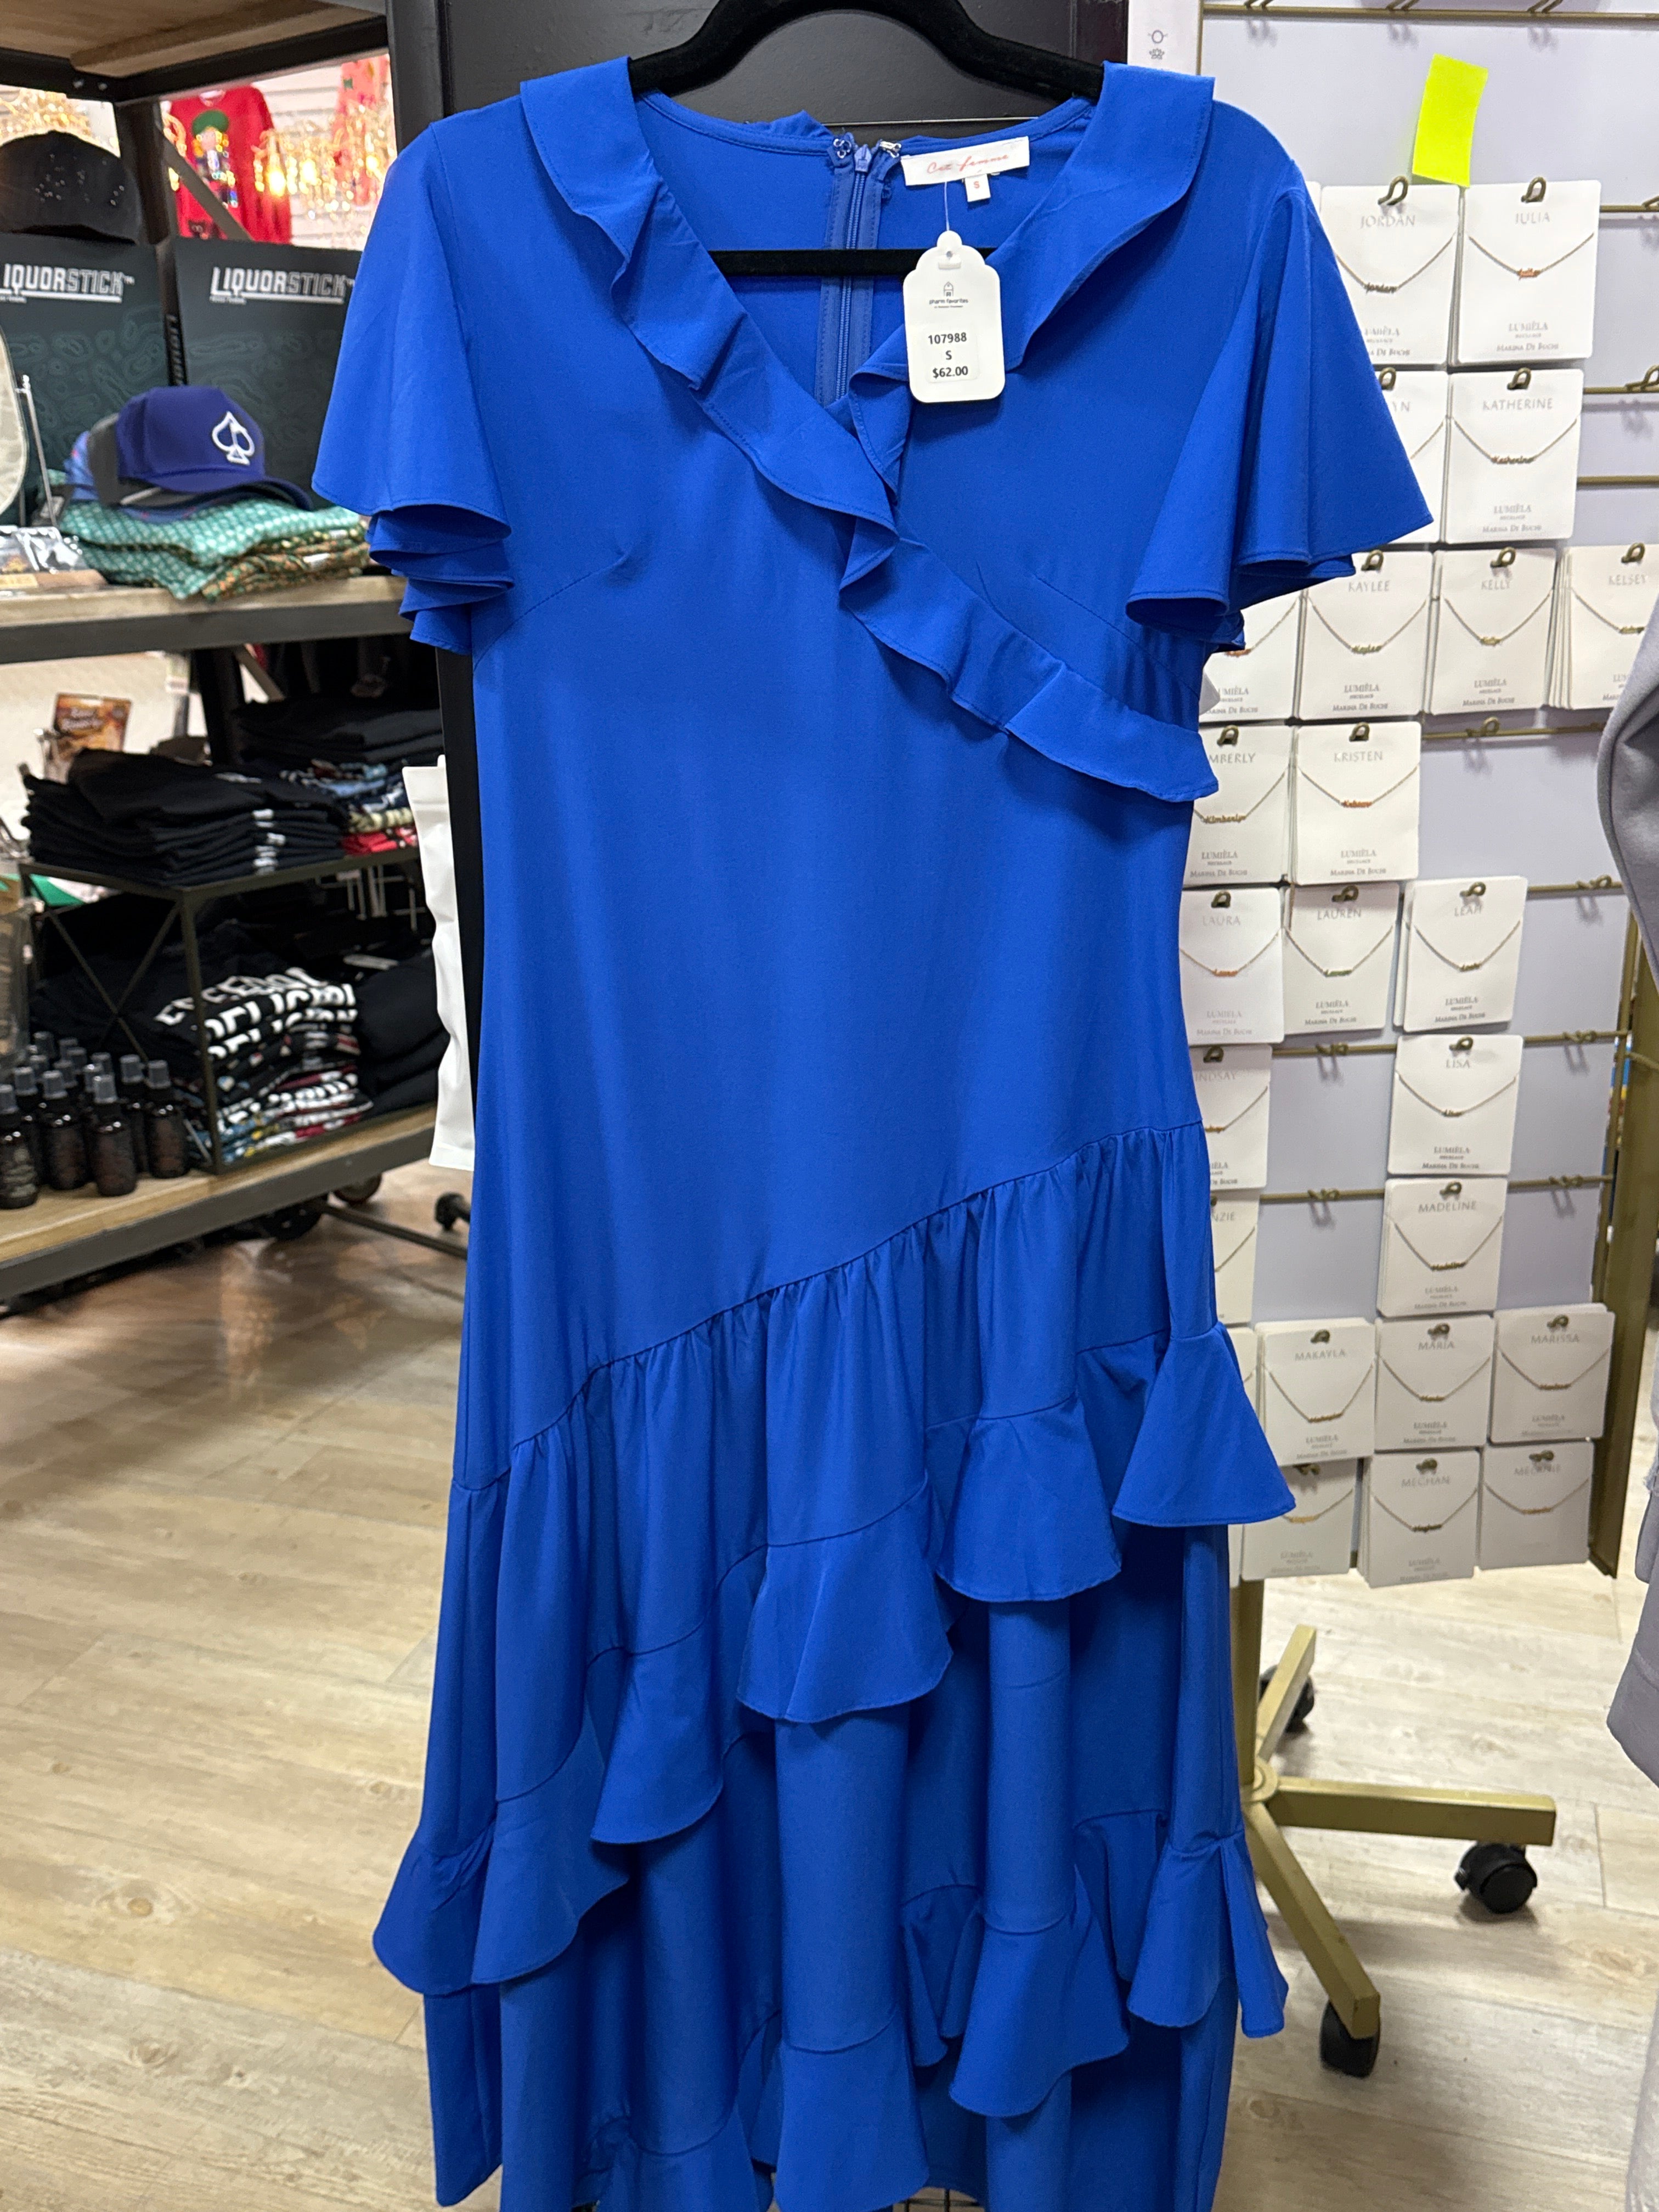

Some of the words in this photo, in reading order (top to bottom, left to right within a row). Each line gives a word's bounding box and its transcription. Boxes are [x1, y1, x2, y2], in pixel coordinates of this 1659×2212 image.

[1359, 215, 1416, 229] JORDAN
[1515, 211, 1550, 224] JULIA
[928, 332, 967, 345] 107988
[945, 350, 952, 360] S
[932, 366, 968, 379] $62.00
[1482, 398, 1554, 411] KATHERINE
[1348, 580, 1390, 592] KAYLEE
[1481, 579, 1511, 590] KELLY
[1608, 574, 1646, 586] KELSEY
[1209, 752, 1256, 764] MBERLY
[1334, 751, 1384, 763] KRISTEN
[1317, 908, 1362, 921] LAUREN
[1454, 906, 1482, 917] LEAH
[1202, 915, 1241, 927] LAURA
[1446, 1058, 1471, 1069] LISA
[1195, 1070, 1238, 1082] INDSAY
[1418, 1200, 1476, 1213] MADELINE
[1531, 1333, 1580, 1344] MARISSA
[1418, 1340, 1455, 1351] MARIA
[1295, 1348, 1347, 1361] MAKAYLA
